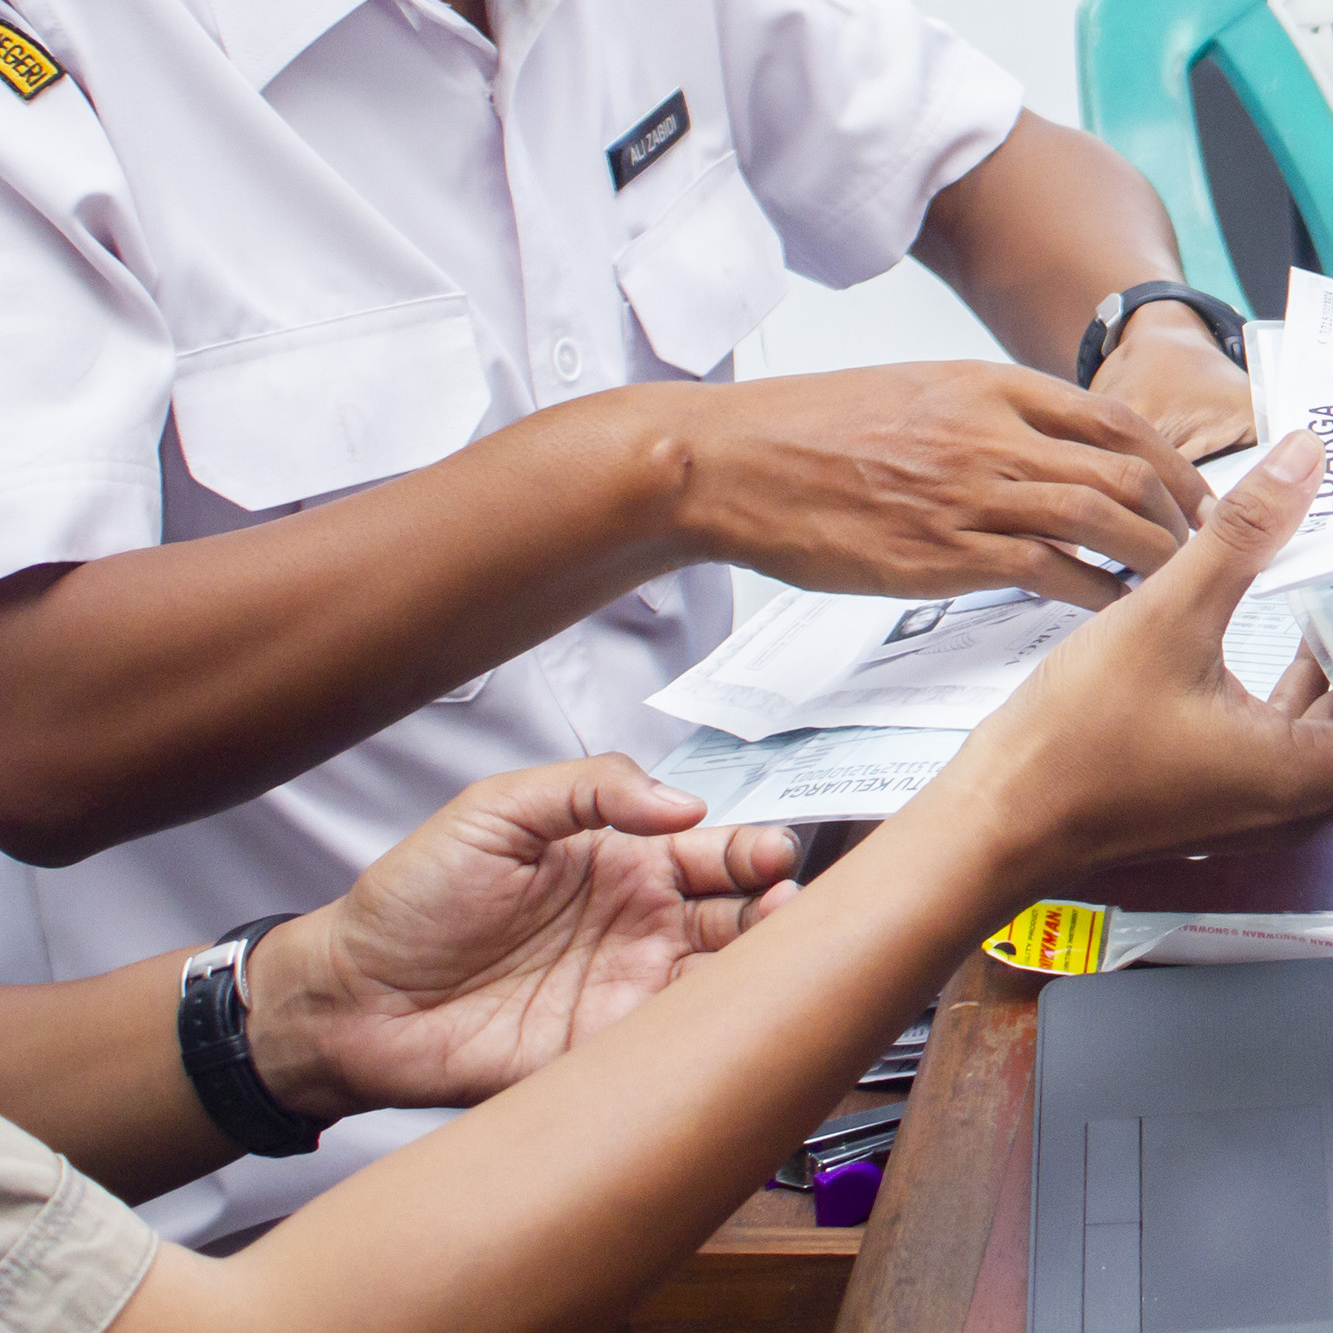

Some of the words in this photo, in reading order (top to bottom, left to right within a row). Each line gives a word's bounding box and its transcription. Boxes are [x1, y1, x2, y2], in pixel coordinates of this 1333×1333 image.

[0, 33, 47, 87] EGERI
[628, 139, 646, 166] ALI
[777, 777, 891, 800] KELUARGA
